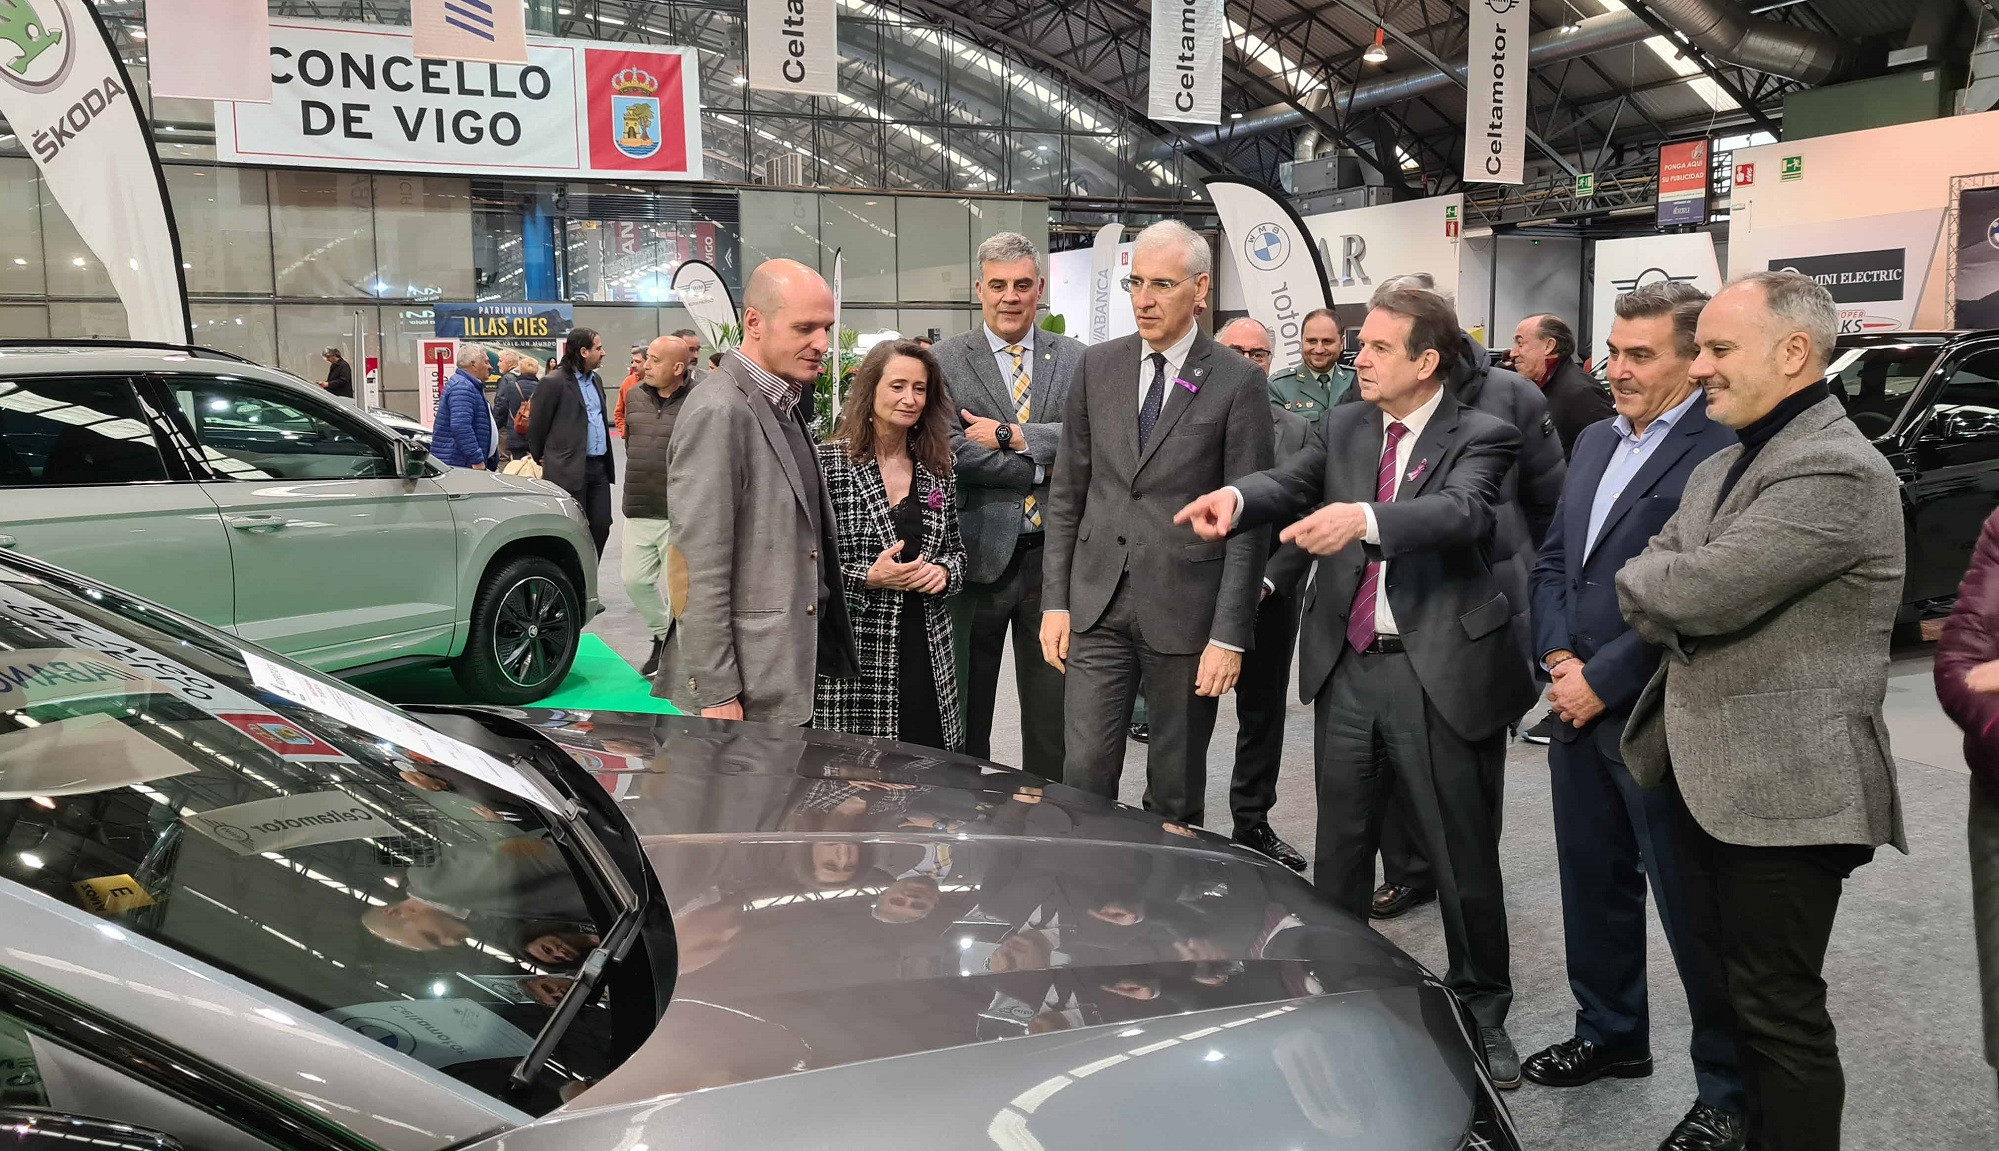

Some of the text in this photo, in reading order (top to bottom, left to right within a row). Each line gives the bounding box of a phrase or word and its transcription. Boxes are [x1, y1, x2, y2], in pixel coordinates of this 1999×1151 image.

[270, 46, 551, 101] CONCELLO
[1486, 23, 1506, 176] Celtamotor
[31, 76, 126, 164] ŠKODA
[301, 100, 522, 146] DE VIGO
[1664, 162, 1687, 171] PONGA
[1670, 172, 1705, 182] PUBLICIDAD
[1809, 268, 1903, 286] MINI ELECTRIC
[478, 306, 533, 315] PATRIMONIO
[1840, 311, 1864, 319] OPER
[463, 316, 548, 336] ILLAS CIES
[1840, 319, 1863, 334] KS
